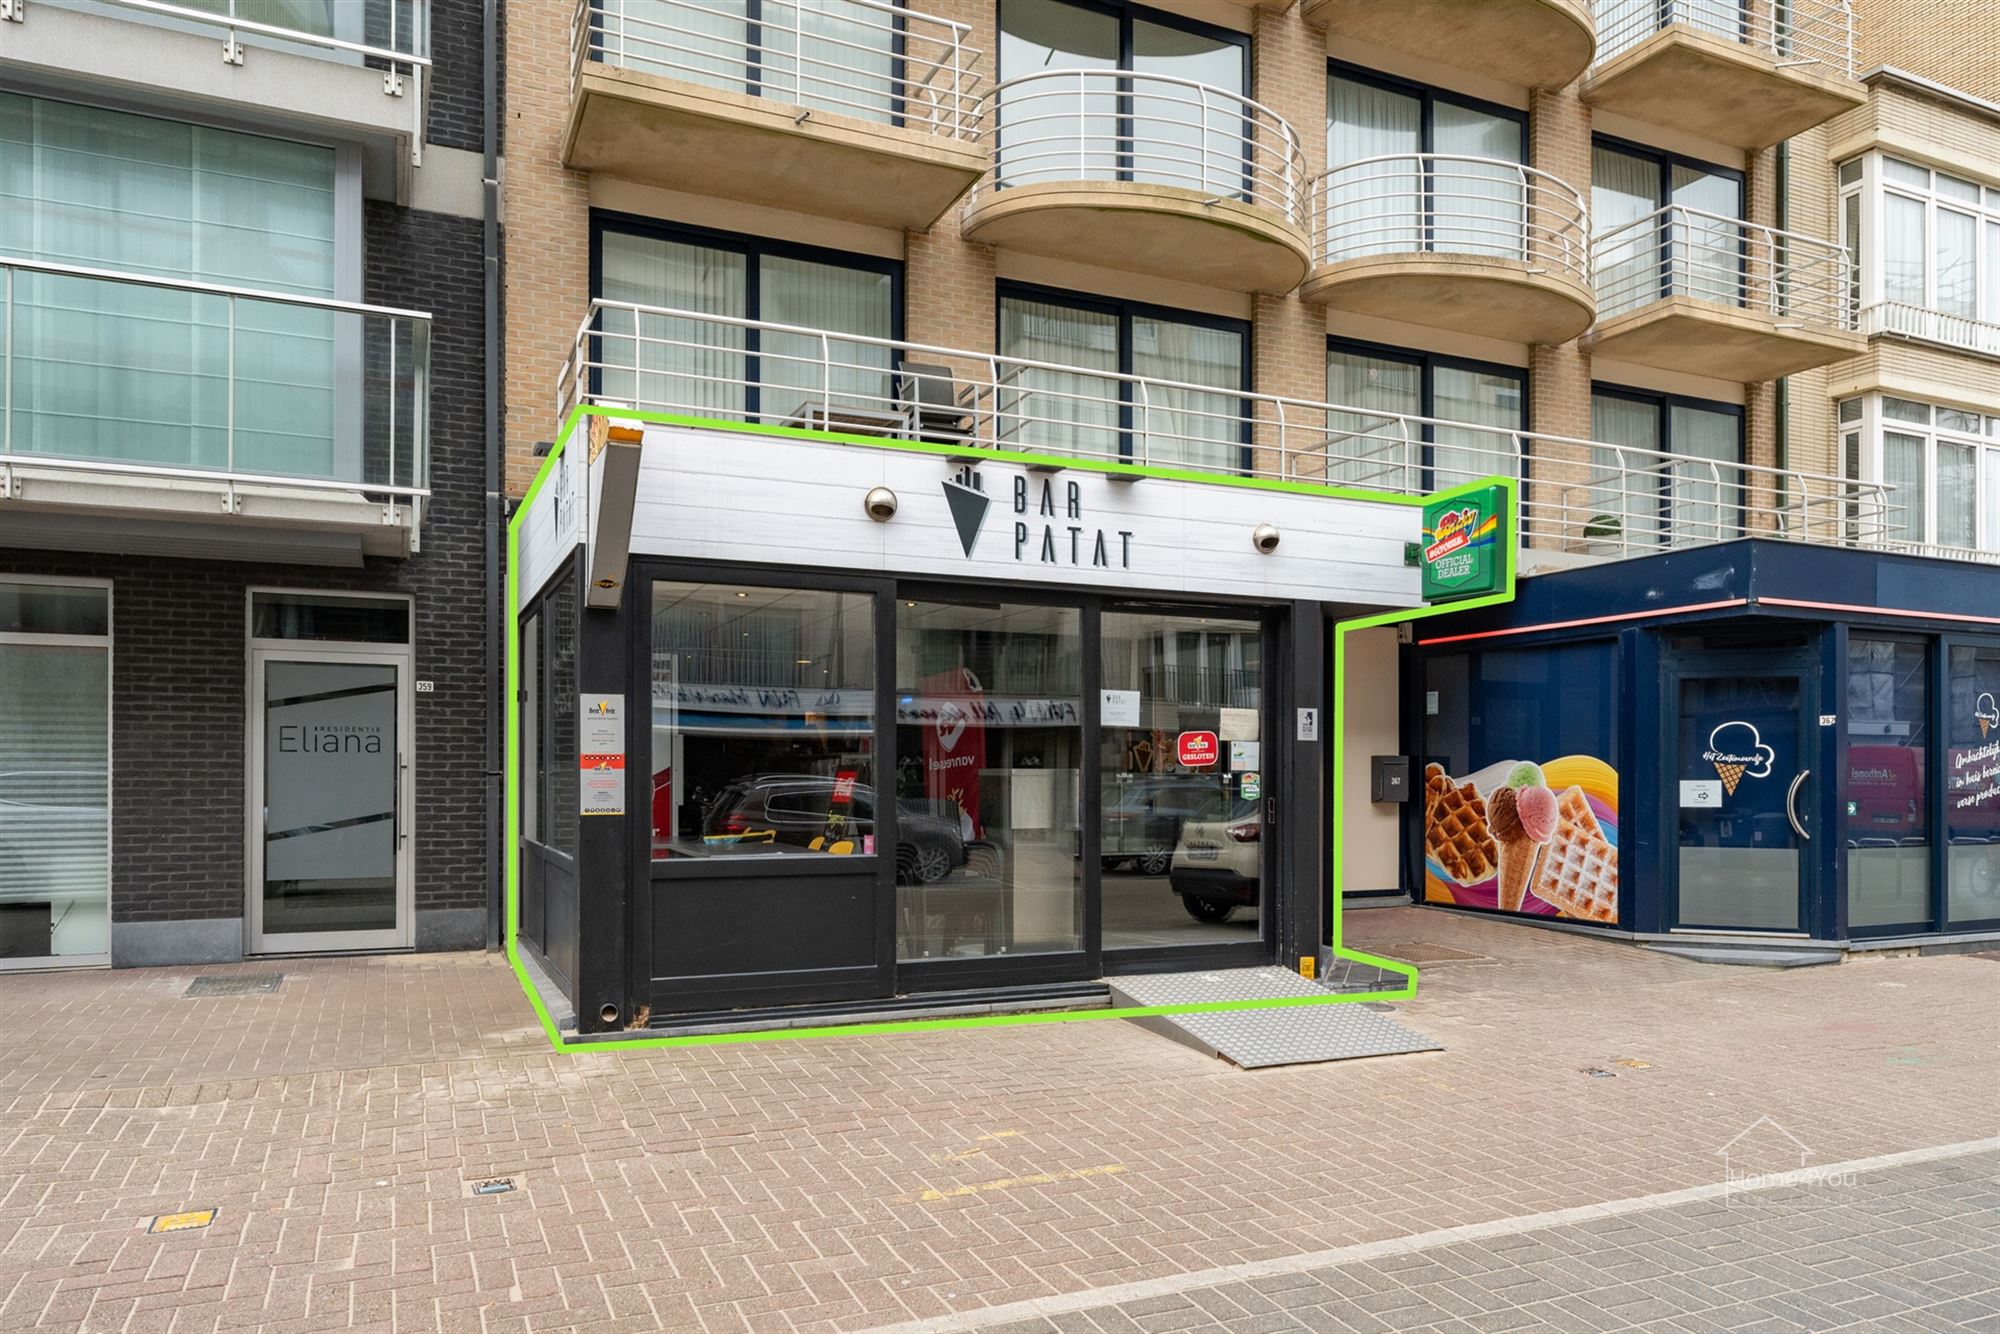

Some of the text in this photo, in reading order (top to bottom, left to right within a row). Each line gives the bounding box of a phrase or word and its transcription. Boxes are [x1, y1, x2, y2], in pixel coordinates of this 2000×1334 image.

[1014, 475, 1081, 518] BAR
[1014, 521, 1133, 568] PATAT
[1435, 553, 1473, 569] OFFICIAL
[1438, 565, 1470, 579] DEALER
[417, 681, 432, 691] 359
[279, 725, 382, 754] Eliana
[1182, 752, 1215, 761] GESLOTEN
[1702, 751, 1716, 762] Het
[1956, 776, 1965, 788] in
[1966, 770, 1981, 786] huis
